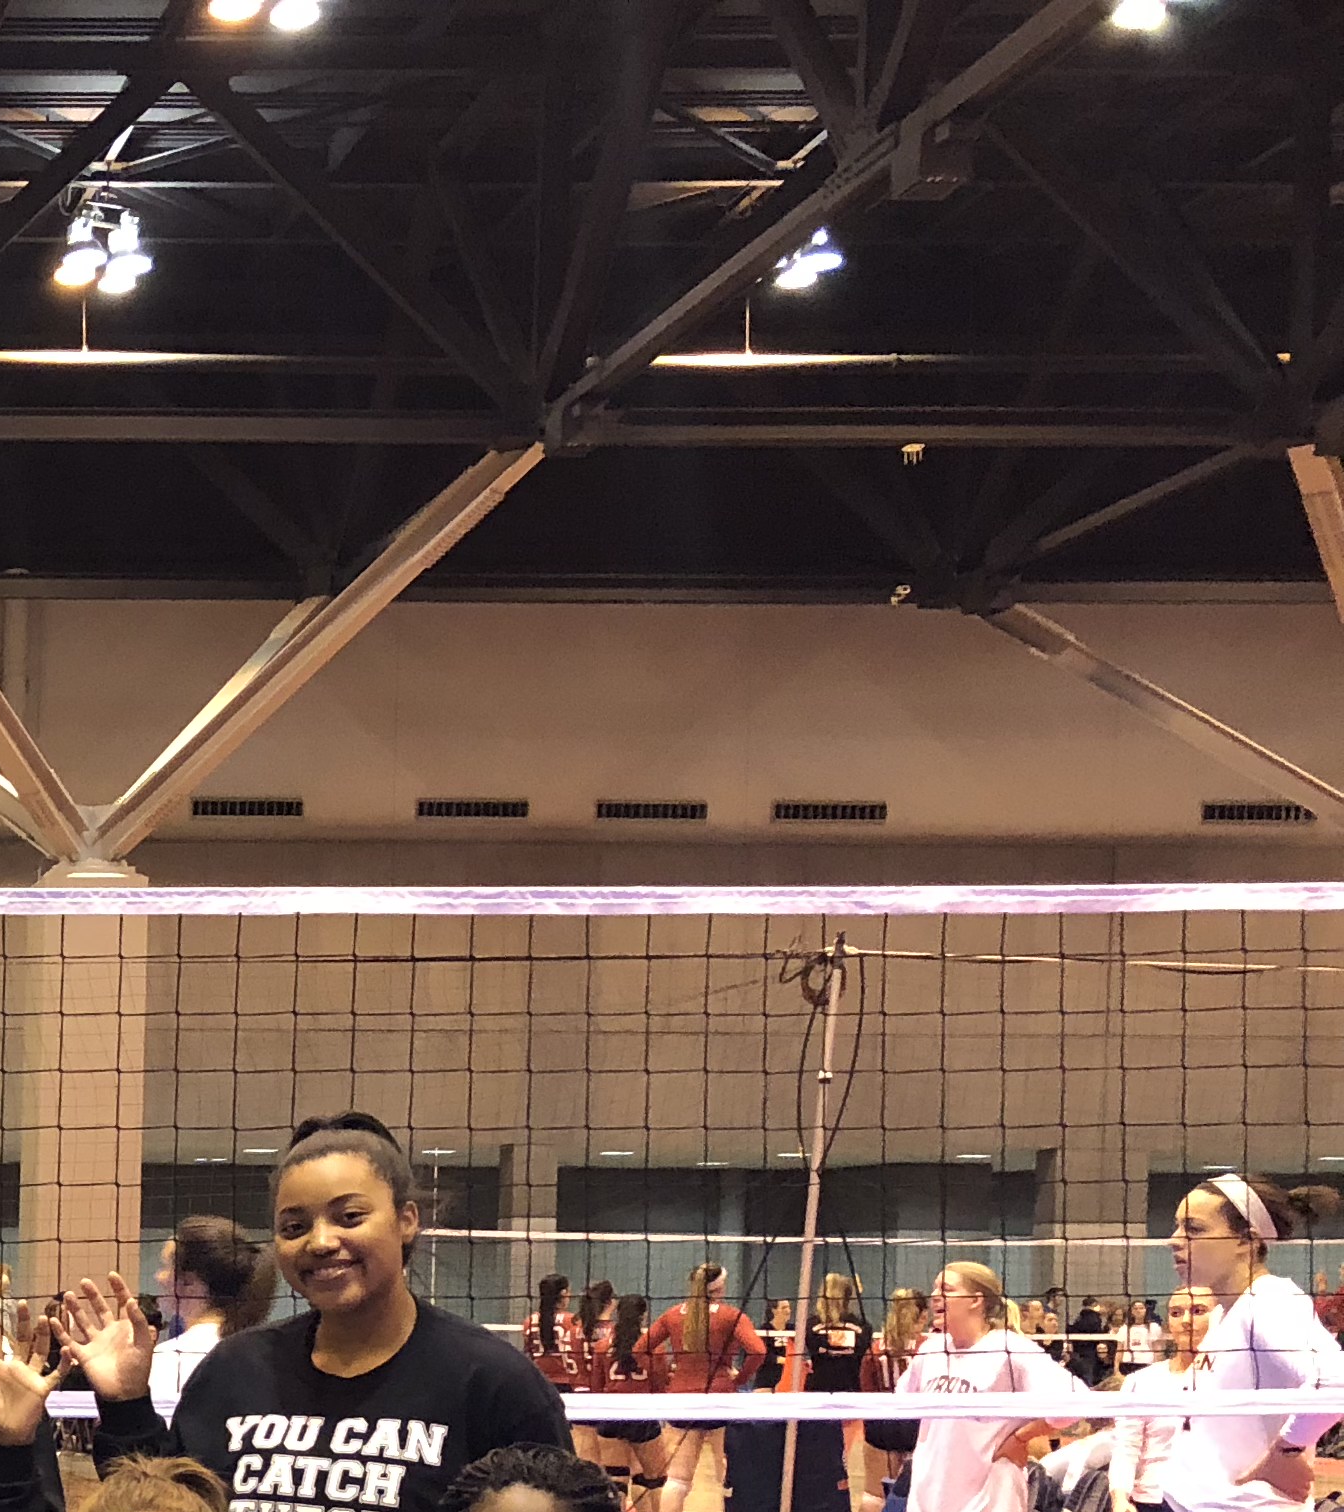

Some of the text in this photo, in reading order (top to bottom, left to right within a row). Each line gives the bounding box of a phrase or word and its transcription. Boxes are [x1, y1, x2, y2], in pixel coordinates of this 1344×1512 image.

[225, 1414, 449, 1467] YOU CAN
[232, 1454, 407, 1508] CATCH
